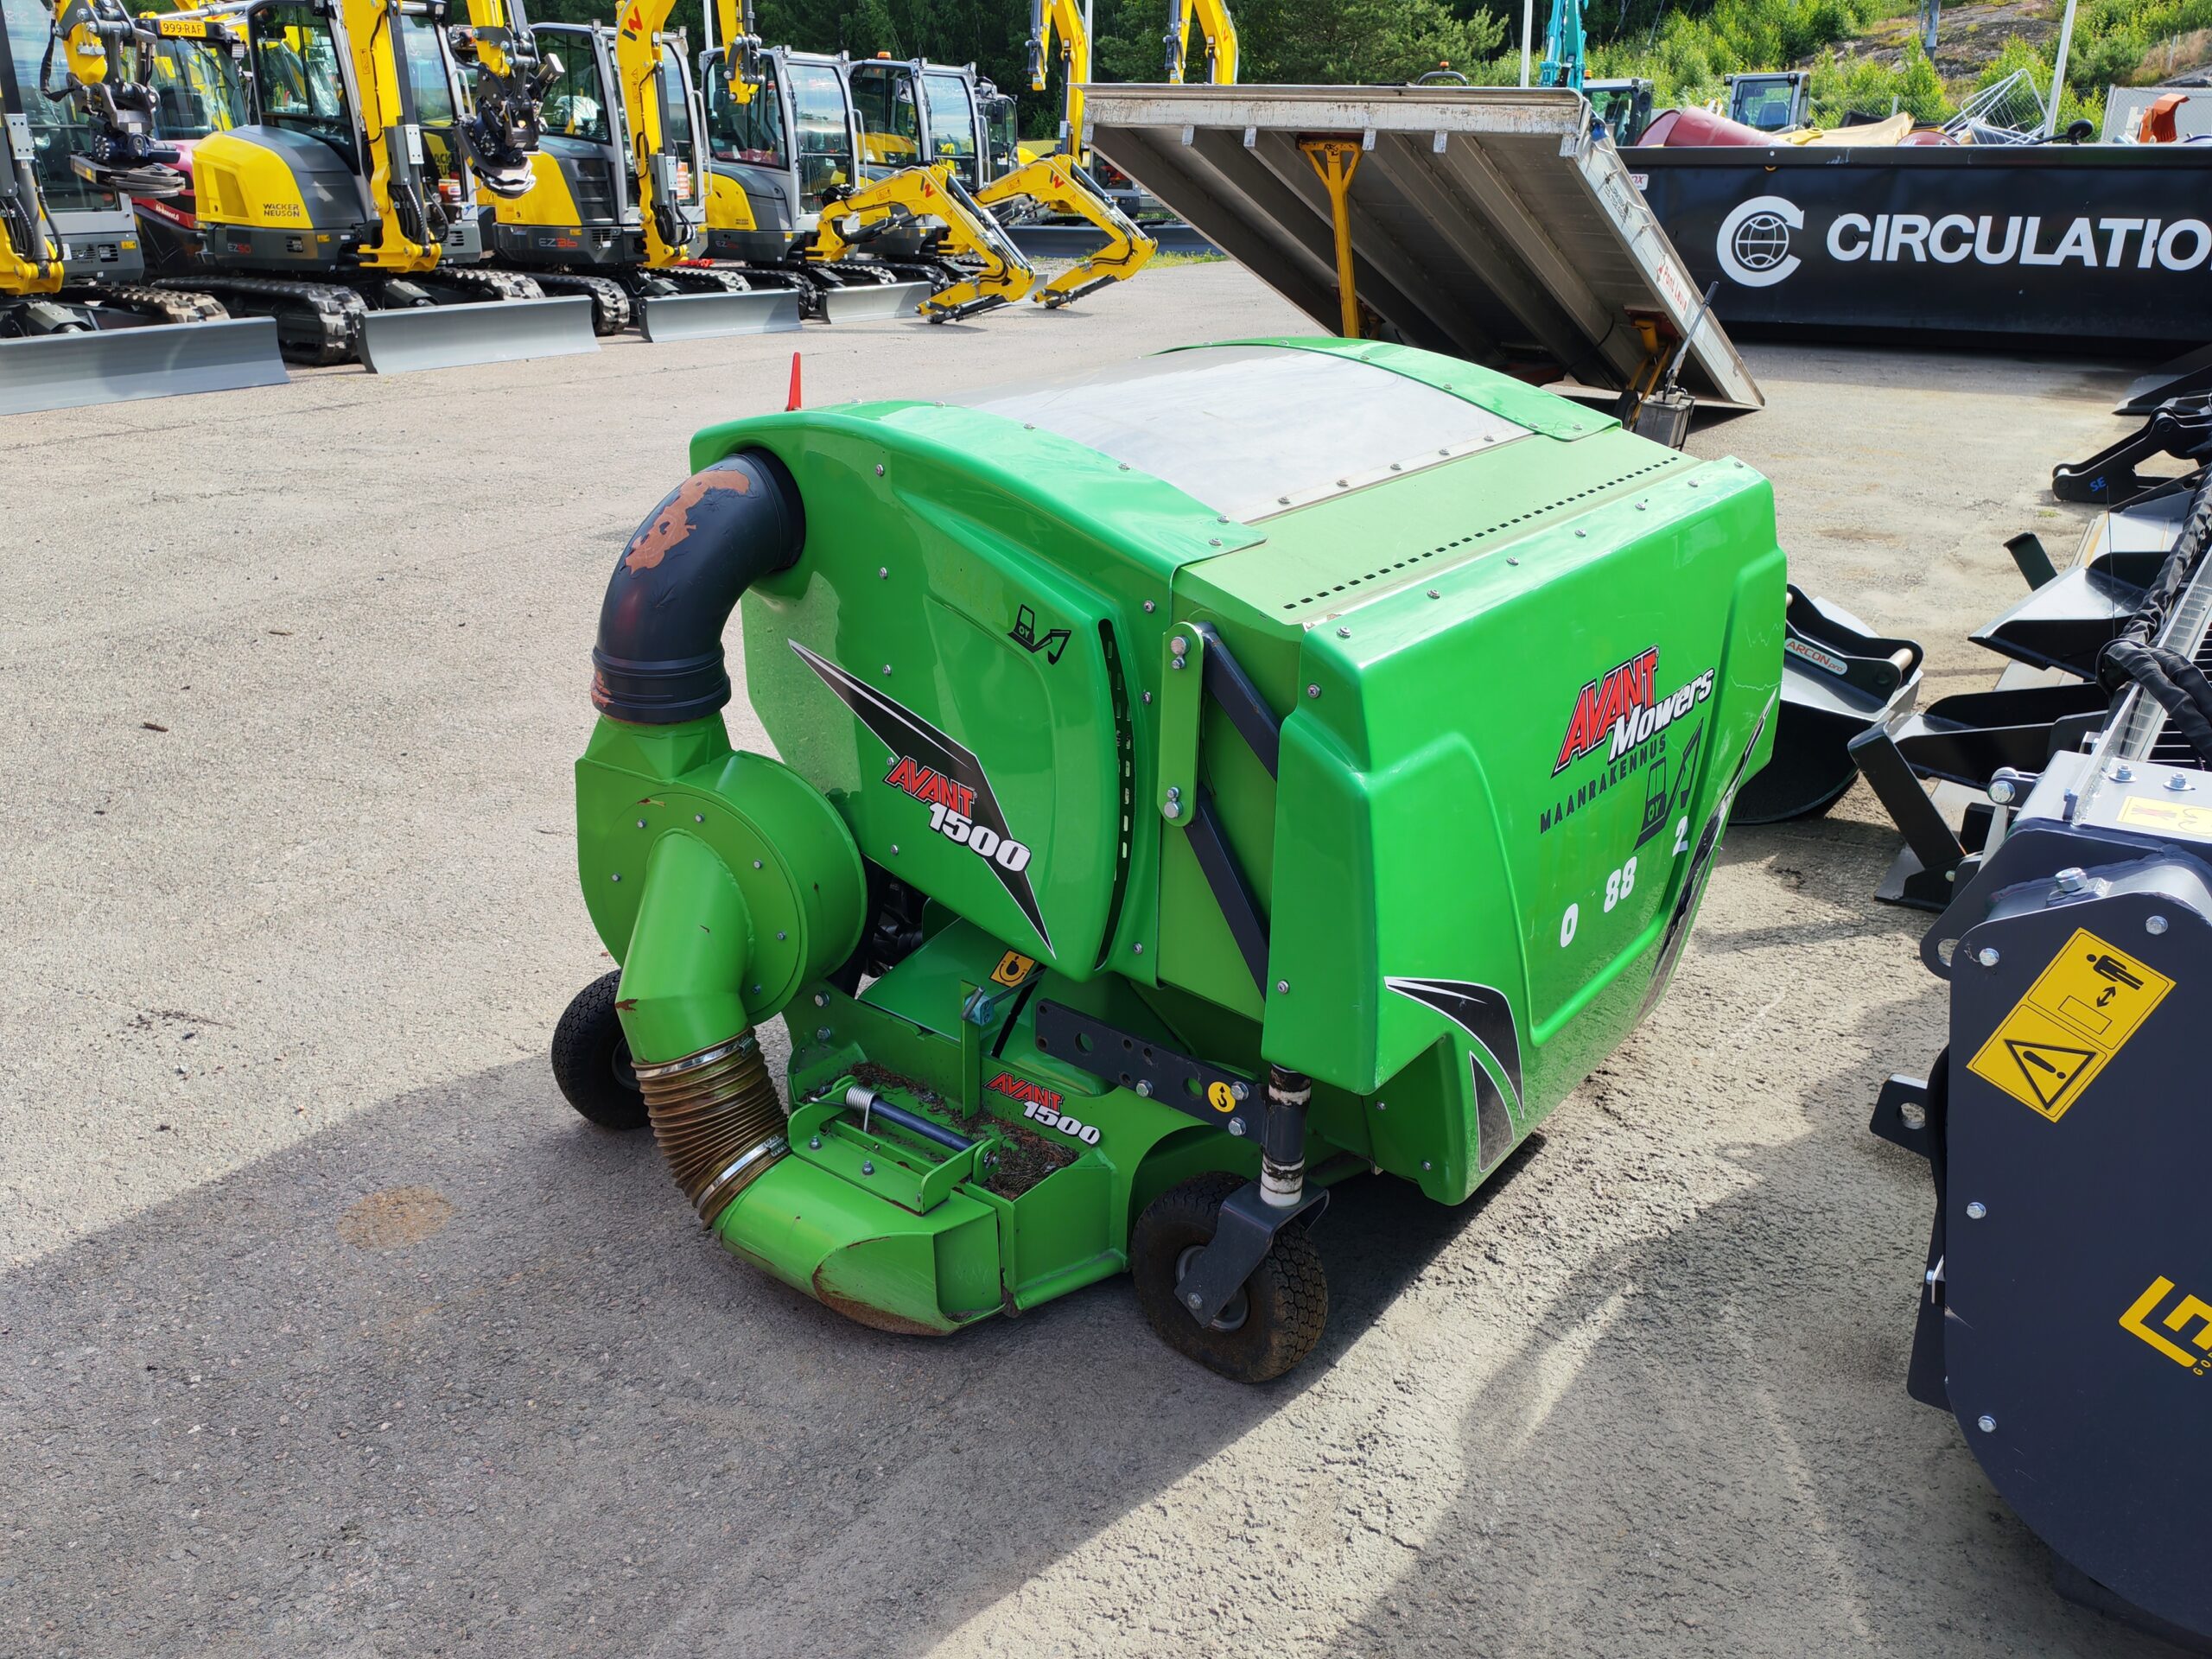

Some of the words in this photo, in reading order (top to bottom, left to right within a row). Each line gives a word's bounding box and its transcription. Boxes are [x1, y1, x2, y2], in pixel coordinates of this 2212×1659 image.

[162, 22, 202, 35] 999-RAF
[1827, 213, 2212, 271] CIRCULATIO
[1019, 626, 1030, 639] OY
[1786, 640, 1831, 666] ARCON
[1554, 646, 1658, 777] AVANT
[1608, 668, 1715, 765] Mowers
[884, 755, 976, 820] AVANT
[1541, 734, 1666, 835] MAANRAKENNUS
[1648, 800, 1661, 822] OY
[929, 802, 1032, 873] 1500
[1604, 856, 1637, 913] 88
[1672, 816, 1688, 857] 2
[984, 1072, 1064, 1112] AVANT
[1023, 1100, 1101, 1145] 1500
